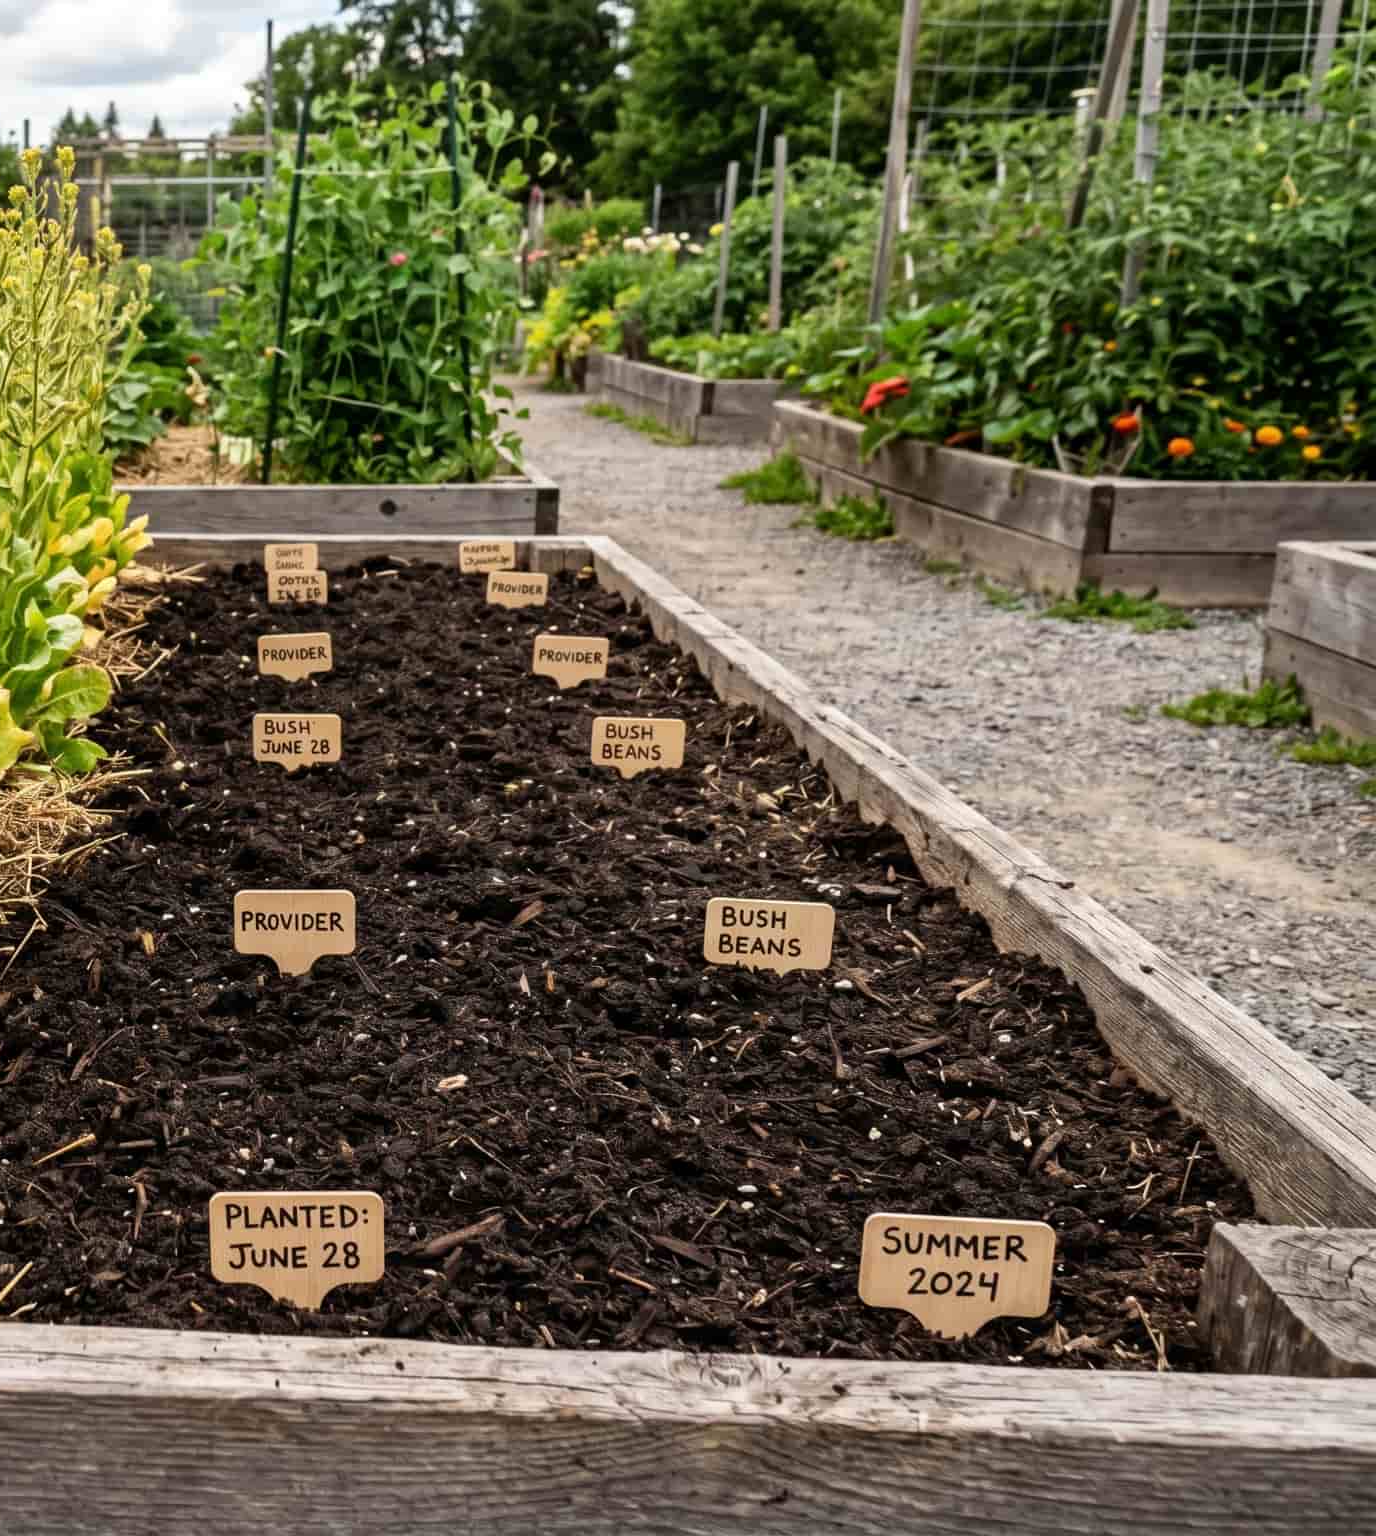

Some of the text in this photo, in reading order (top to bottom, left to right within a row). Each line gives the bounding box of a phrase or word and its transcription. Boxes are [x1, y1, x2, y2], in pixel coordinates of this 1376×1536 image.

[491, 581, 543, 595] PROVIDER
[262, 646, 327, 662] PROVIDER
[538, 648, 603, 665] PROVIDER
[264, 719, 311, 735] BUSH
[605, 723, 654, 740] BUSH
[260, 739, 331, 755] JUNE 28
[601, 743, 662, 761] BEANS
[241, 910, 345, 932] PROVIDER
[721, 905, 787, 931] BUSH
[718, 933, 802, 958] BEANS
[225, 1203, 369, 1230] PLANTED:
[882, 1226, 1028, 1263] SUMMER
[228, 1241, 361, 1270] JUNE 28
[907, 1267, 1000, 1303] 2024
